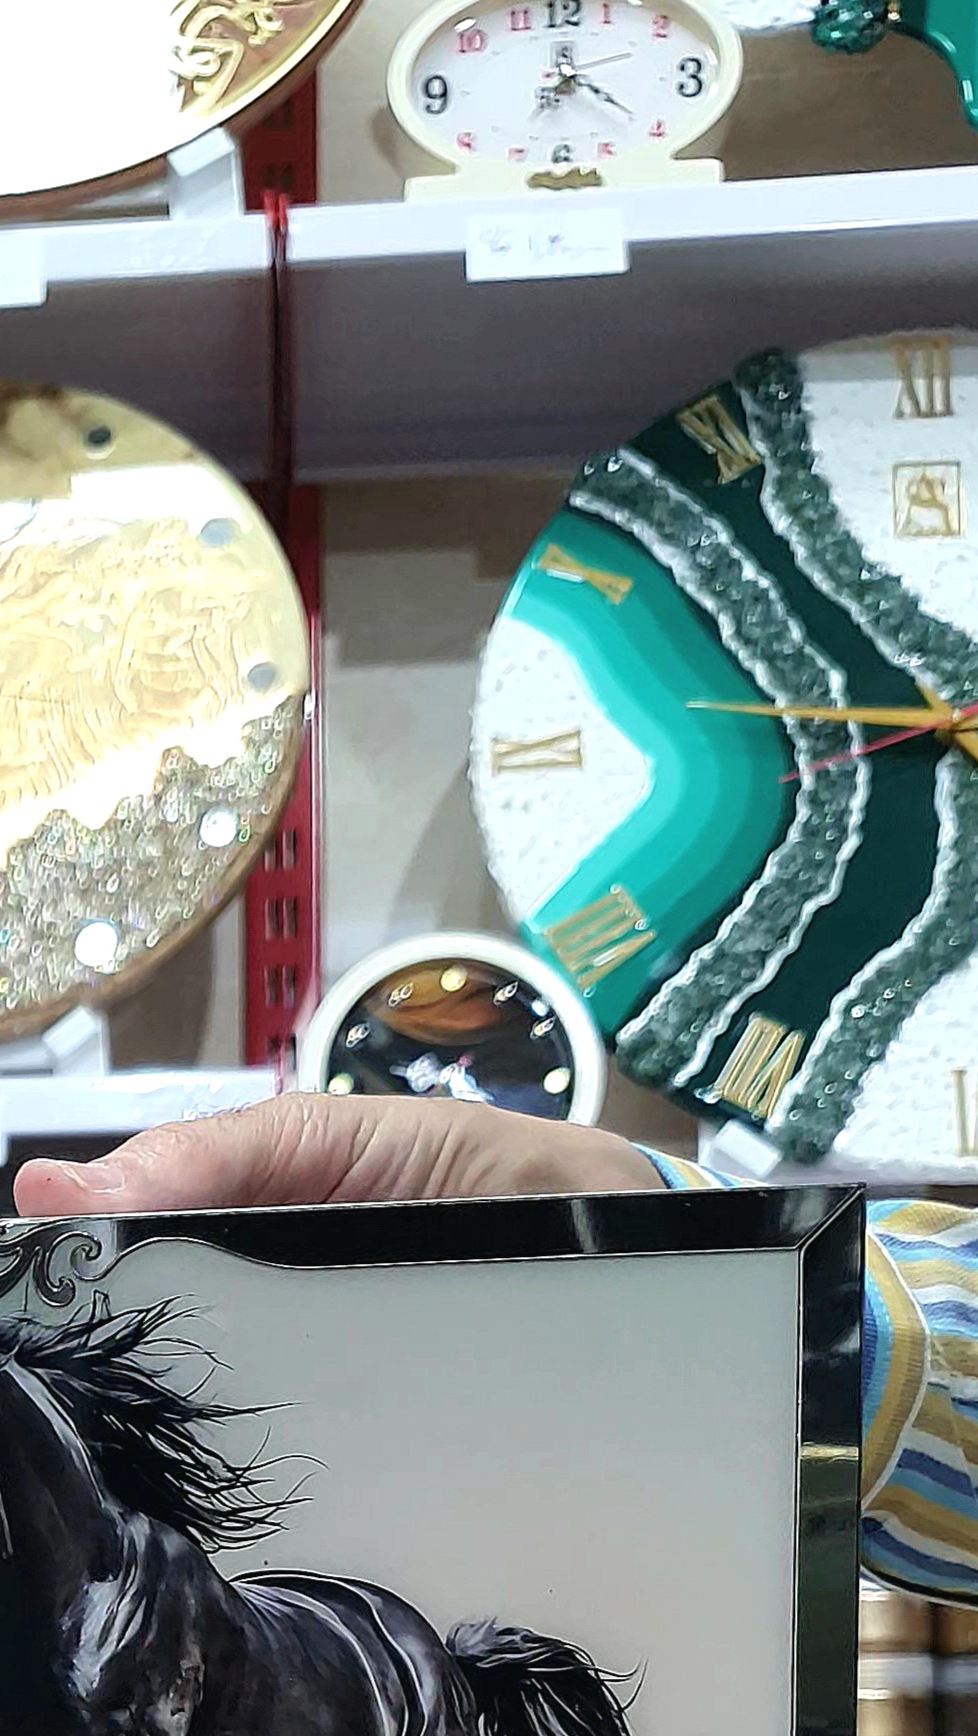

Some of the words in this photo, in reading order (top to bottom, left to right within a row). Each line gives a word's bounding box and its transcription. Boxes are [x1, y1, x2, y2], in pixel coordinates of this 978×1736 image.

[509, 8, 532, 32] 11
[545, 0, 582, 29] 12
[602, 2, 612, 25] 1
[457, 27, 488, 54] 10
[676, 56, 704, 98] 3
[424, 74, 449, 115] 9
